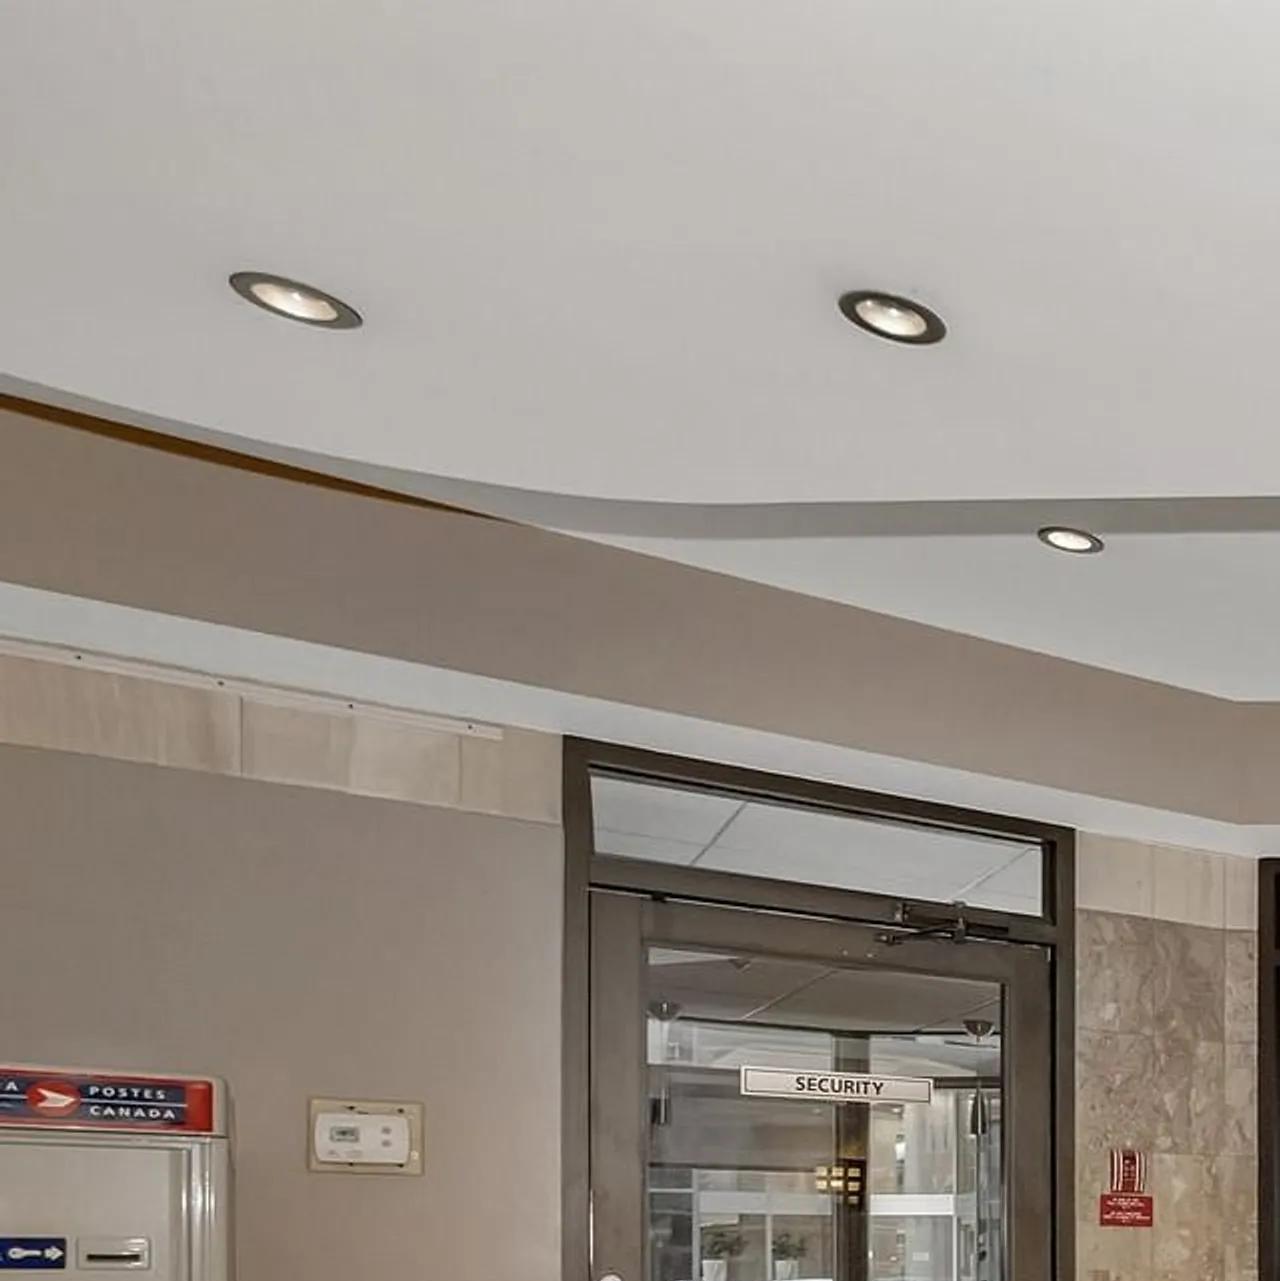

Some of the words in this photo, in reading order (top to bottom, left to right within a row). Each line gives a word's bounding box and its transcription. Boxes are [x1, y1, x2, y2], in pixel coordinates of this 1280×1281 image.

[89, 1086, 166, 1099] POSTES
[796, 1076, 884, 1096] SECURITY
[90, 1105, 176, 1120] CANADA
